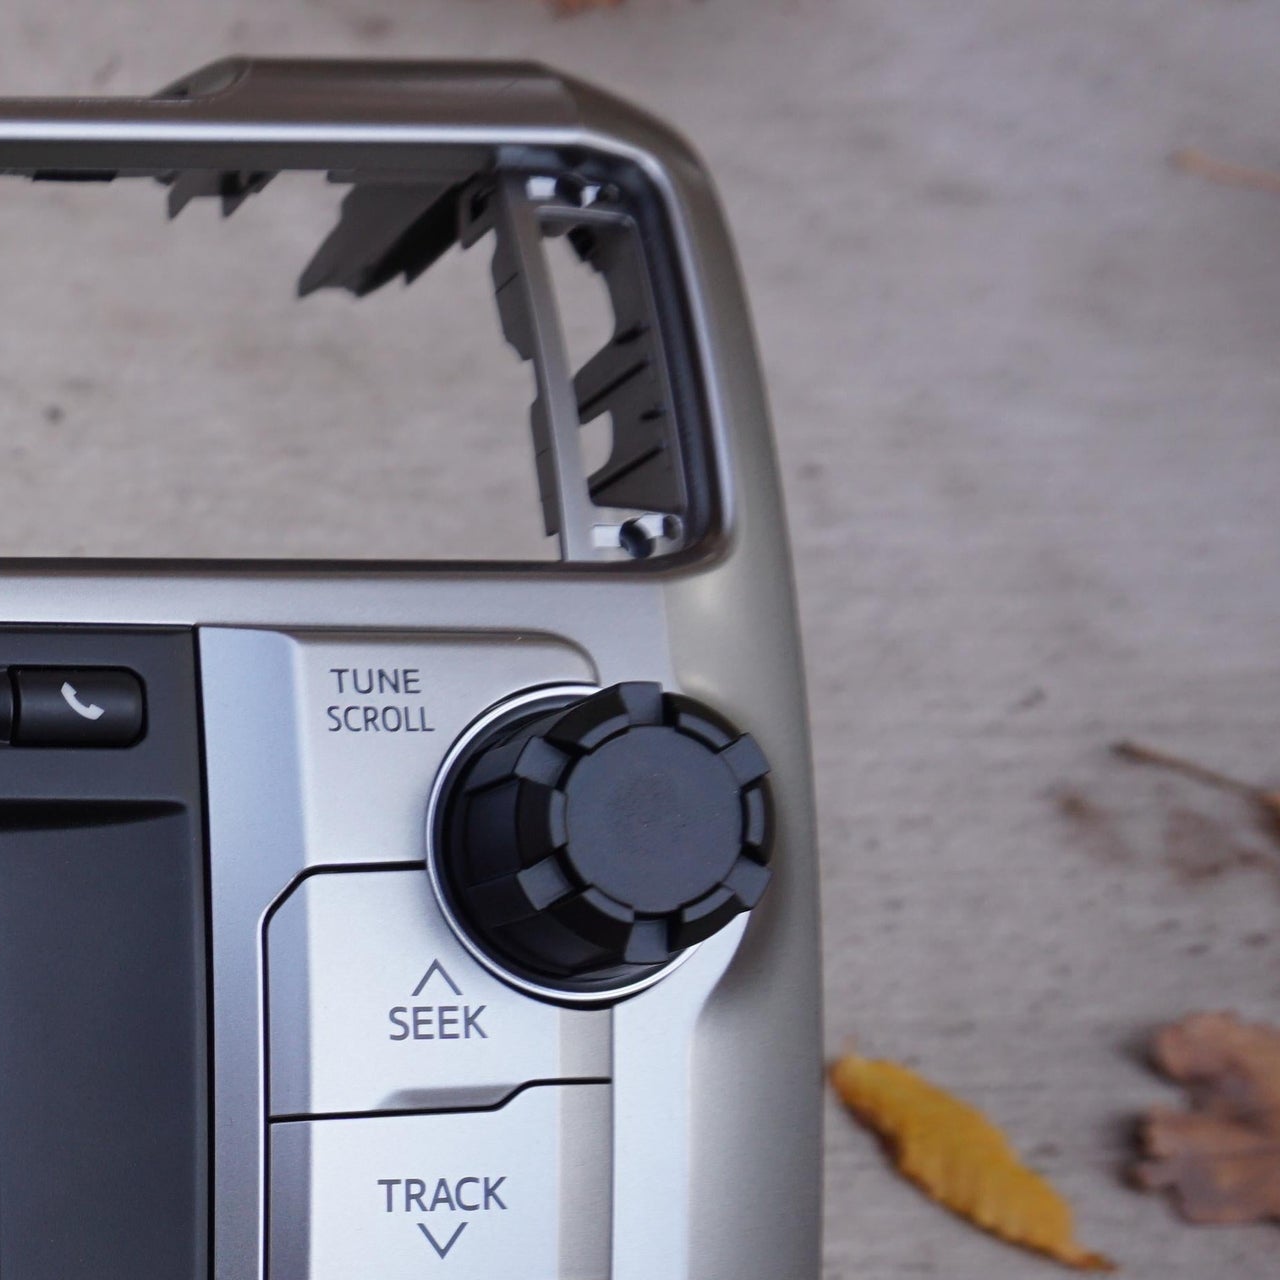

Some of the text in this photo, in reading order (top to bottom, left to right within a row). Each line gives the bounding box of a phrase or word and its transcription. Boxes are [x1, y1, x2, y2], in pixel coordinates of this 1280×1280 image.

[330, 669, 421, 695] TUNE
[327, 706, 435, 732] SCROLL
[388, 1005, 488, 1041] SEEK
[377, 1176, 508, 1212] TRACK
